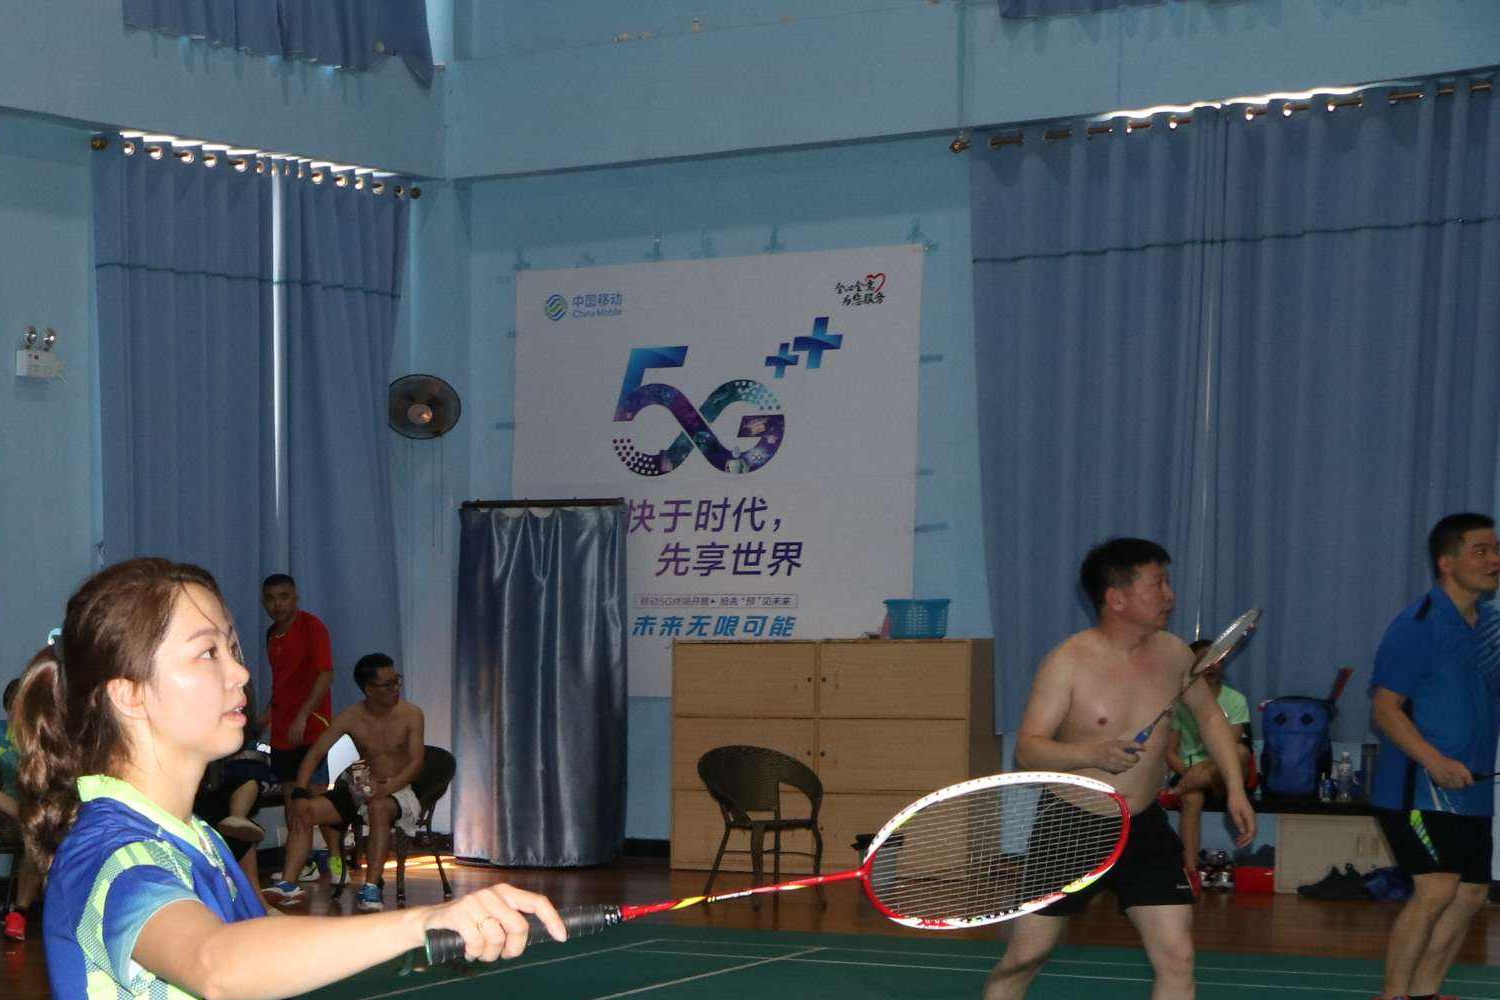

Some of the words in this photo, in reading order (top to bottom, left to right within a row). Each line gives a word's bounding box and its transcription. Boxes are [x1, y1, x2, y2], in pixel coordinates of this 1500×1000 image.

[572, 292, 623, 308] 中国移动
[572, 309, 596, 319] China
[655, 541, 803, 577] 先享世界
[632, 615, 796, 637] 未来无限可能
